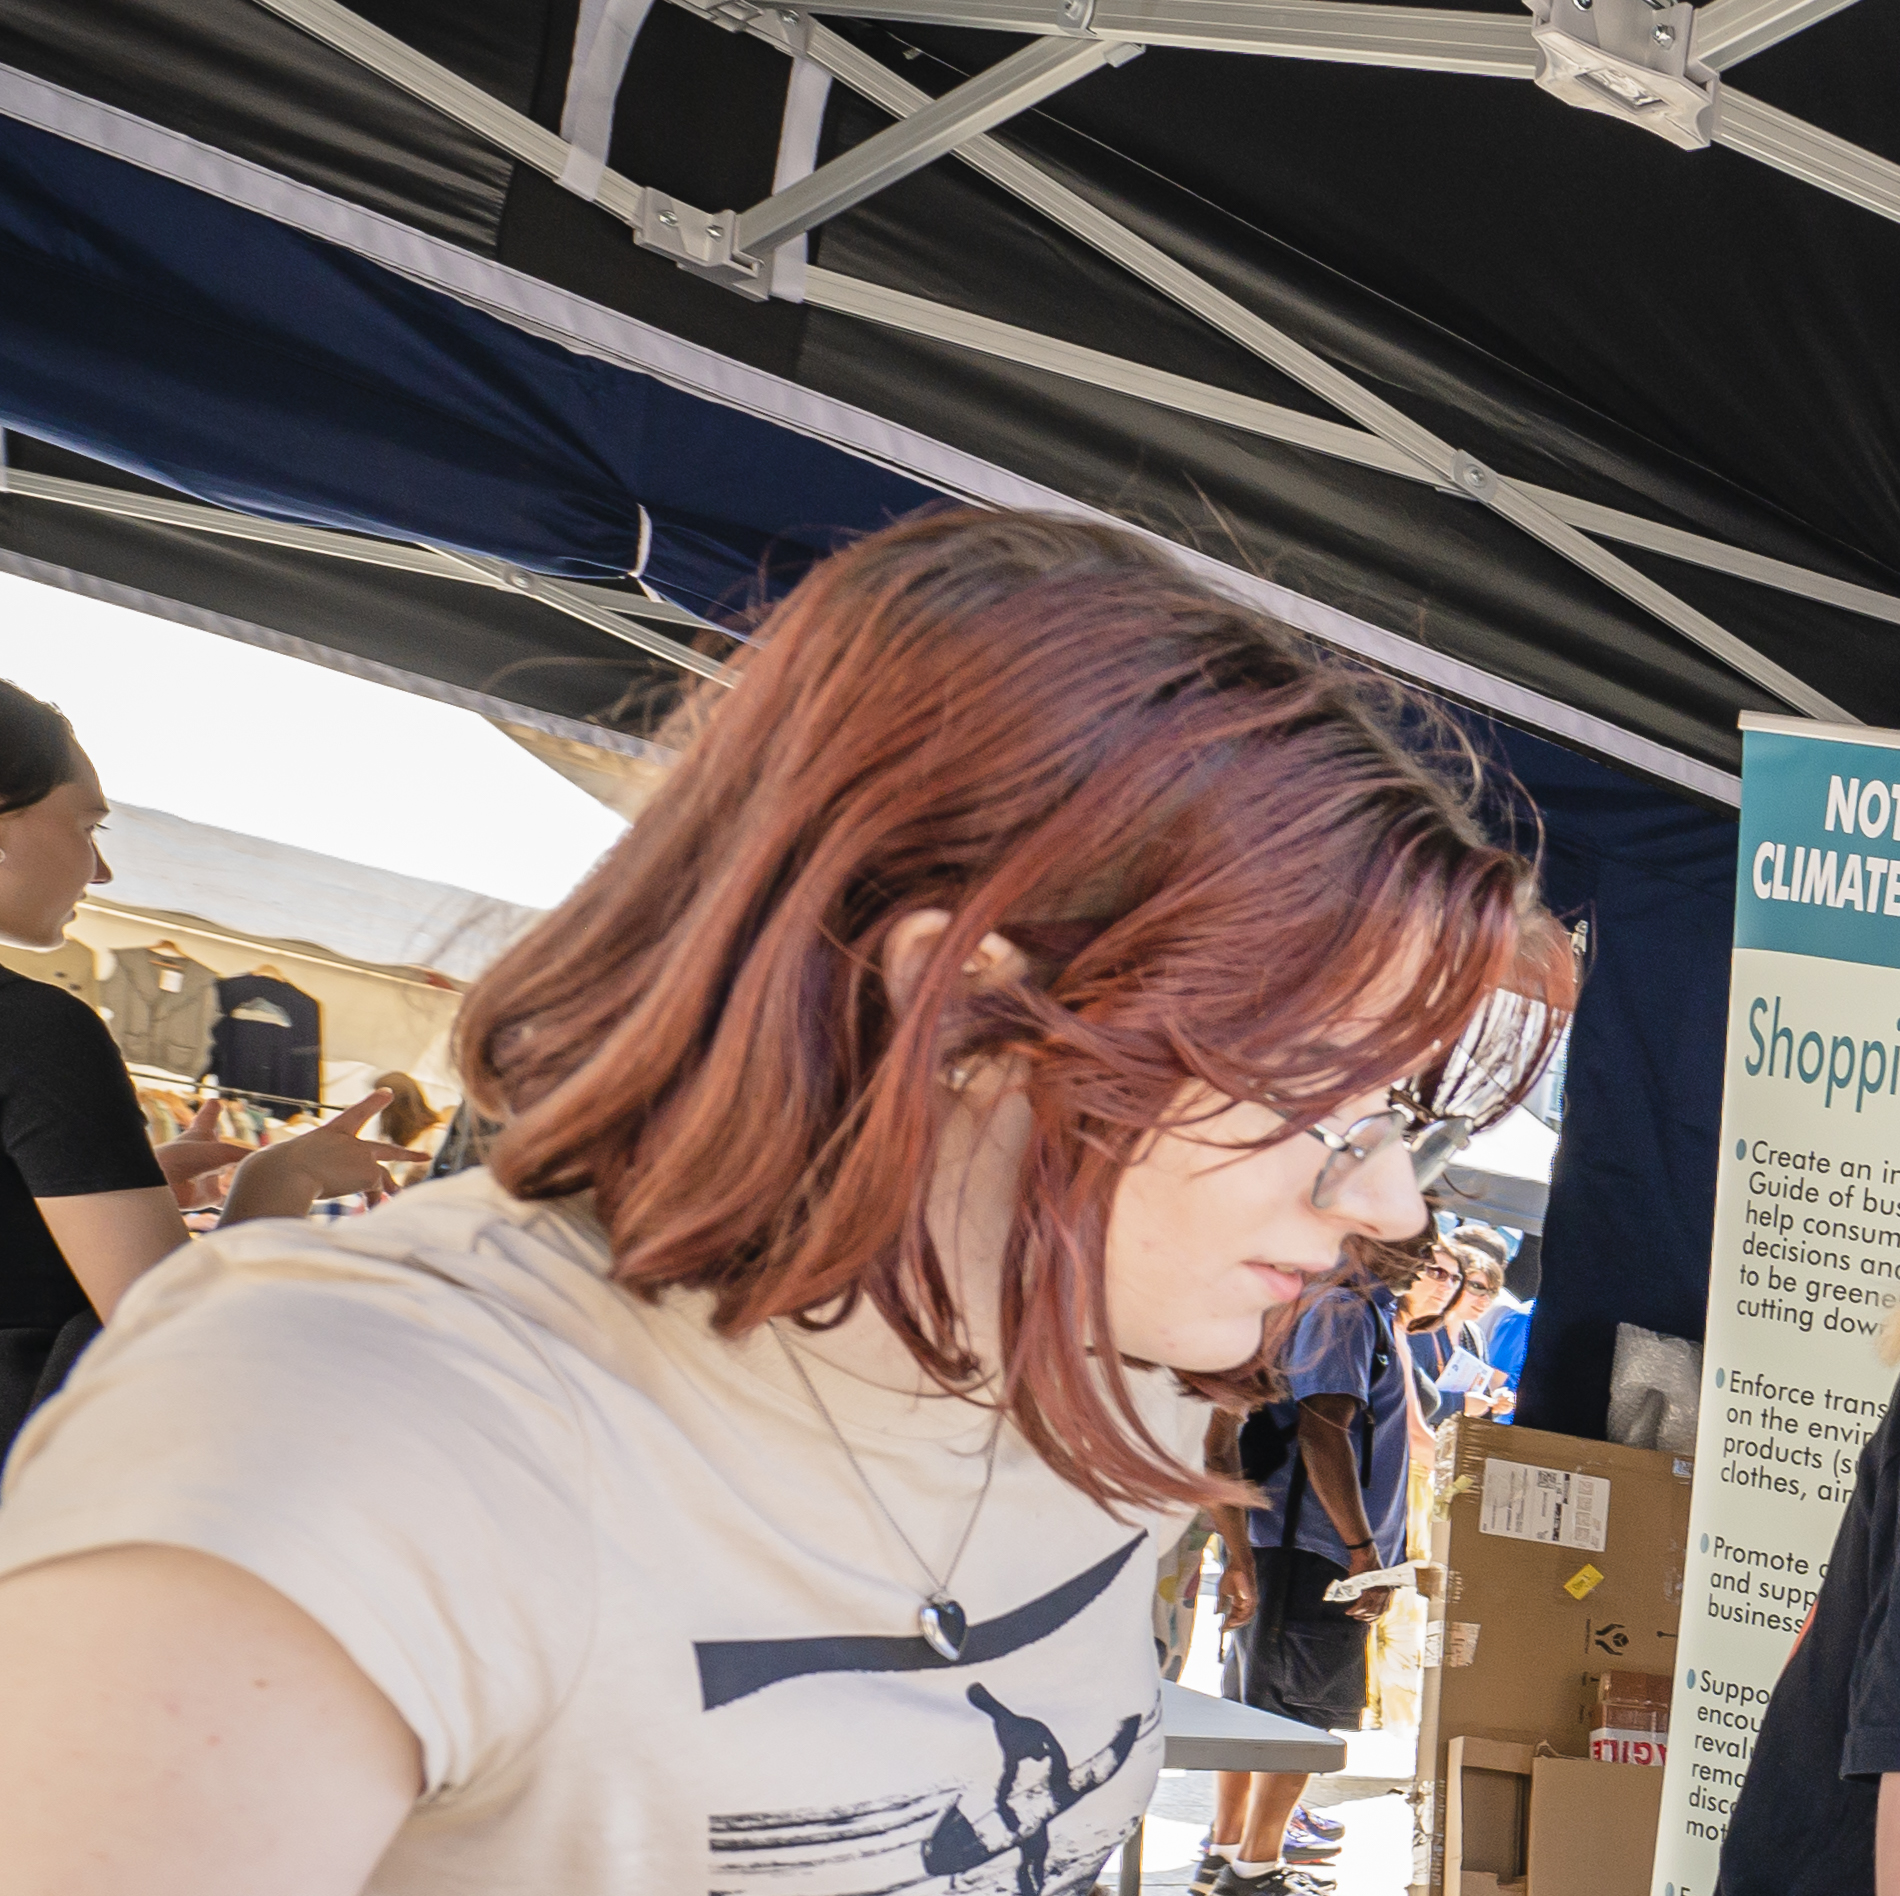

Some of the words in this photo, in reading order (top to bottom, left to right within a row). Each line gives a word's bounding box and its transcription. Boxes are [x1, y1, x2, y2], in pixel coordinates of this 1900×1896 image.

[1751, 1140, 1832, 1175] Create
[1840, 1160, 1872, 1181] an
[1749, 1171, 1820, 1203] Guide
[1828, 1185, 1856, 1209] of
[1745, 1200, 1794, 1236] help
[1743, 1231, 1851, 1271] decisions
[1740, 1264, 1760, 1287] to
[1768, 1265, 1797, 1292] be
[1736, 1298, 1814, 1333] cutting
[1823, 1307, 1883, 1337] dow
[1729, 1370, 1815, 1407] Enforce
[1824, 1388, 1889, 1420] trans
[1727, 1406, 1753, 1426] on
[1760, 1406, 1799, 1434] the
[1723, 1436, 1823, 1470] products
[1720, 1460, 1807, 1501] clothes,
[1713, 1535, 1811, 1576] Promote
[1710, 1570, 1751, 1595] and
[1758, 1580, 1819, 1612] supp
[1700, 1669, 1771, 1707] Suppo
[1697, 1704, 1761, 1734] encou
